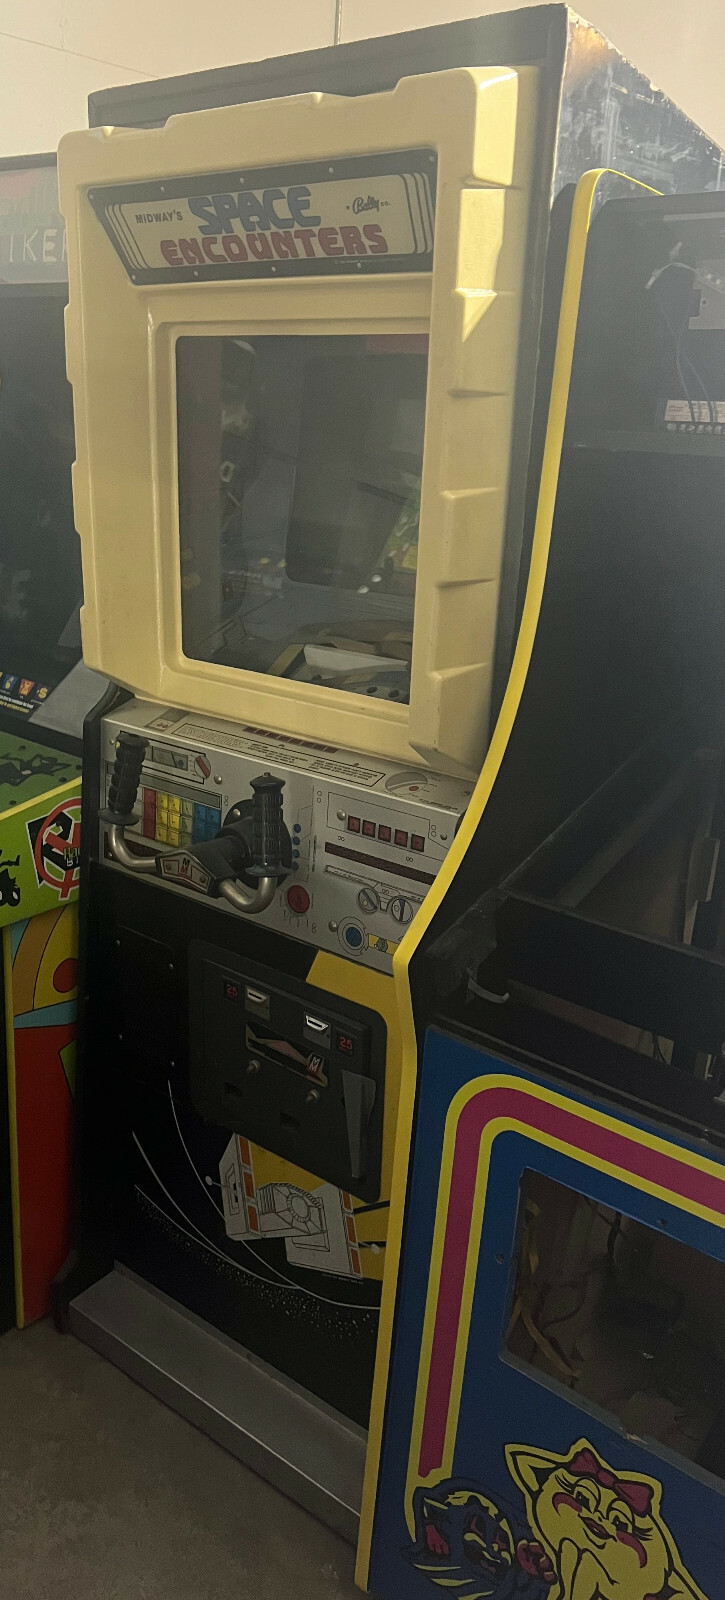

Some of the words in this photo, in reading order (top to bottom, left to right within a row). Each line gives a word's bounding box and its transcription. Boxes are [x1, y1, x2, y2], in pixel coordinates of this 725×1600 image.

[135, 210, 184, 224] MIDWAY'S
[187, 186, 321, 236] SPACE
[352, 195, 379, 215] Bally
[9, 228, 67, 263] IKE
[160, 224, 389, 266] ENCOUNTERS
[339, 1036, 353, 1050] 25
